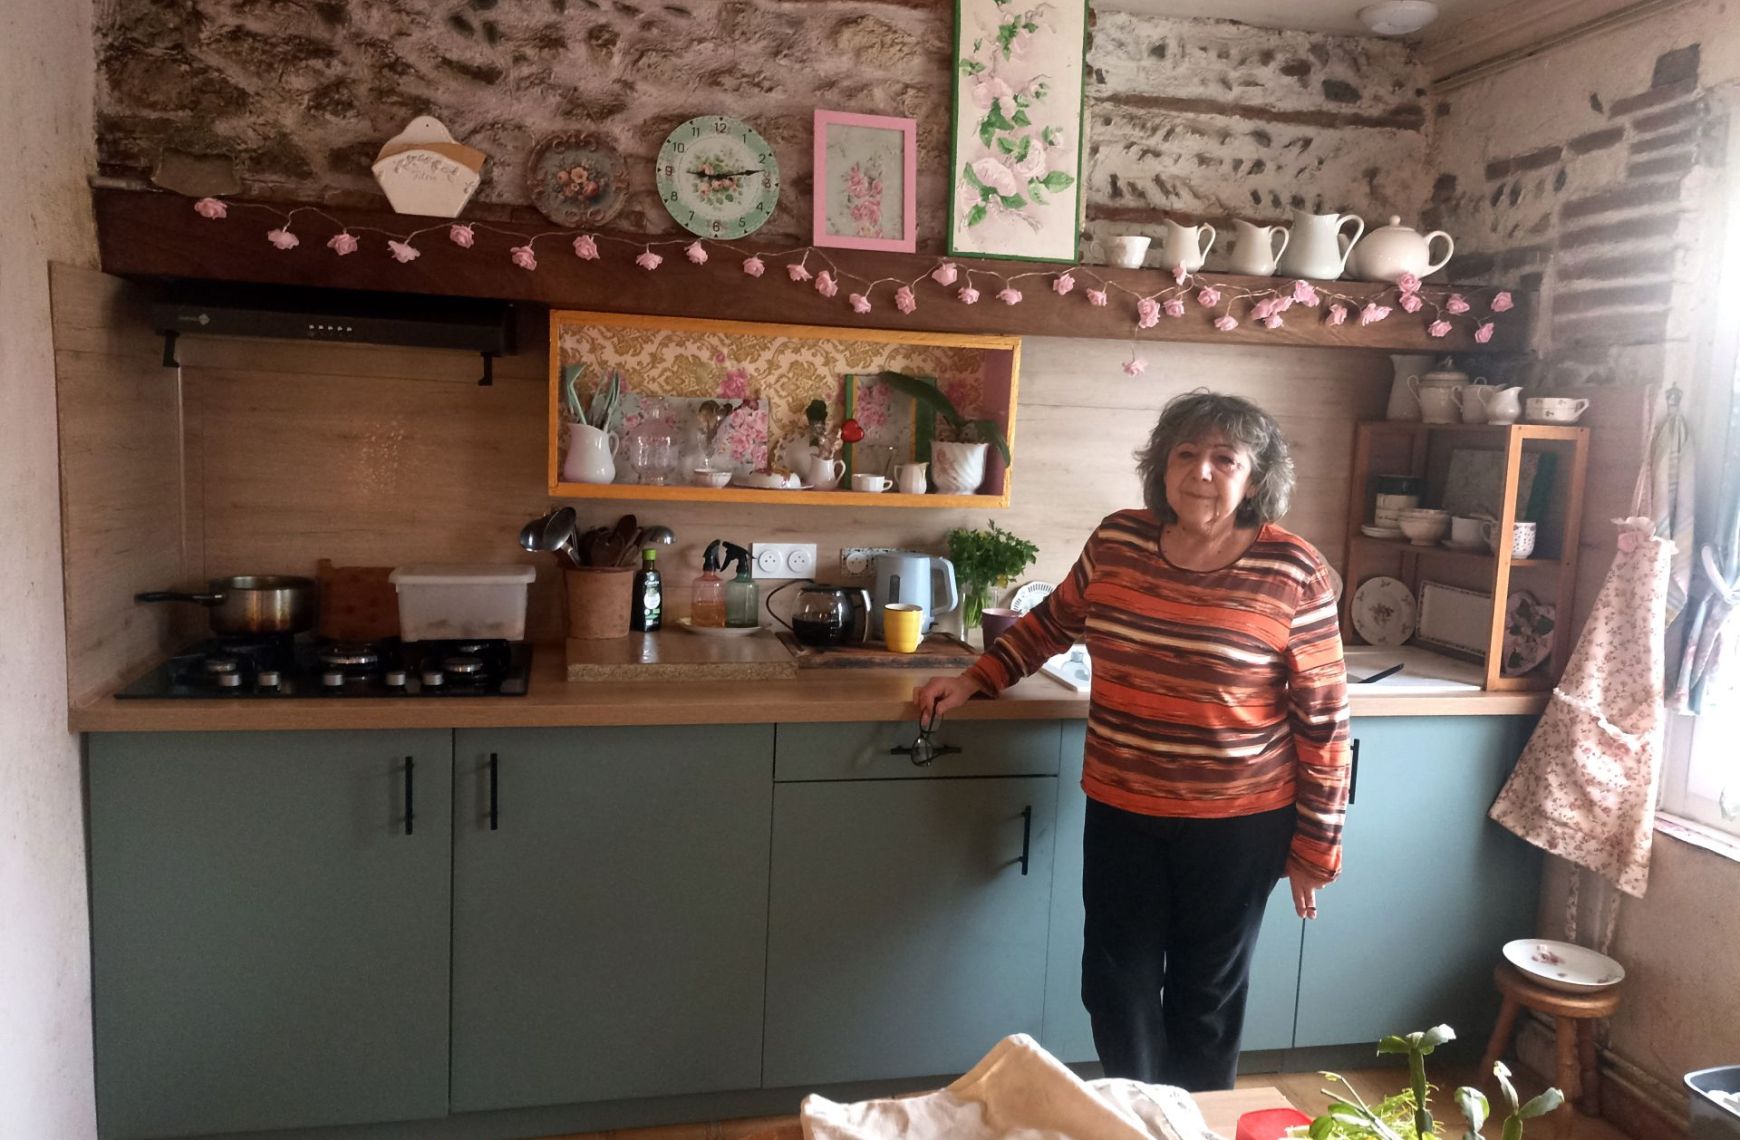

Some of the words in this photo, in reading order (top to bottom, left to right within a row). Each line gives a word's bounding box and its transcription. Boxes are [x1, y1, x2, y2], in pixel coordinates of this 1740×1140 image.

[692, 127, 700, 137] 11
[714, 122, 727, 134] 12
[742, 133, 747, 144] 1
[672, 142, 685, 153] 10
[759, 153, 766, 164] 2
[665, 165, 673, 176] 9
[670, 191, 678, 202] 8
[756, 202, 764, 212] 4
[688, 210, 695, 221] 7
[712, 221, 720, 232] 6
[739, 216, 746, 228] 5
